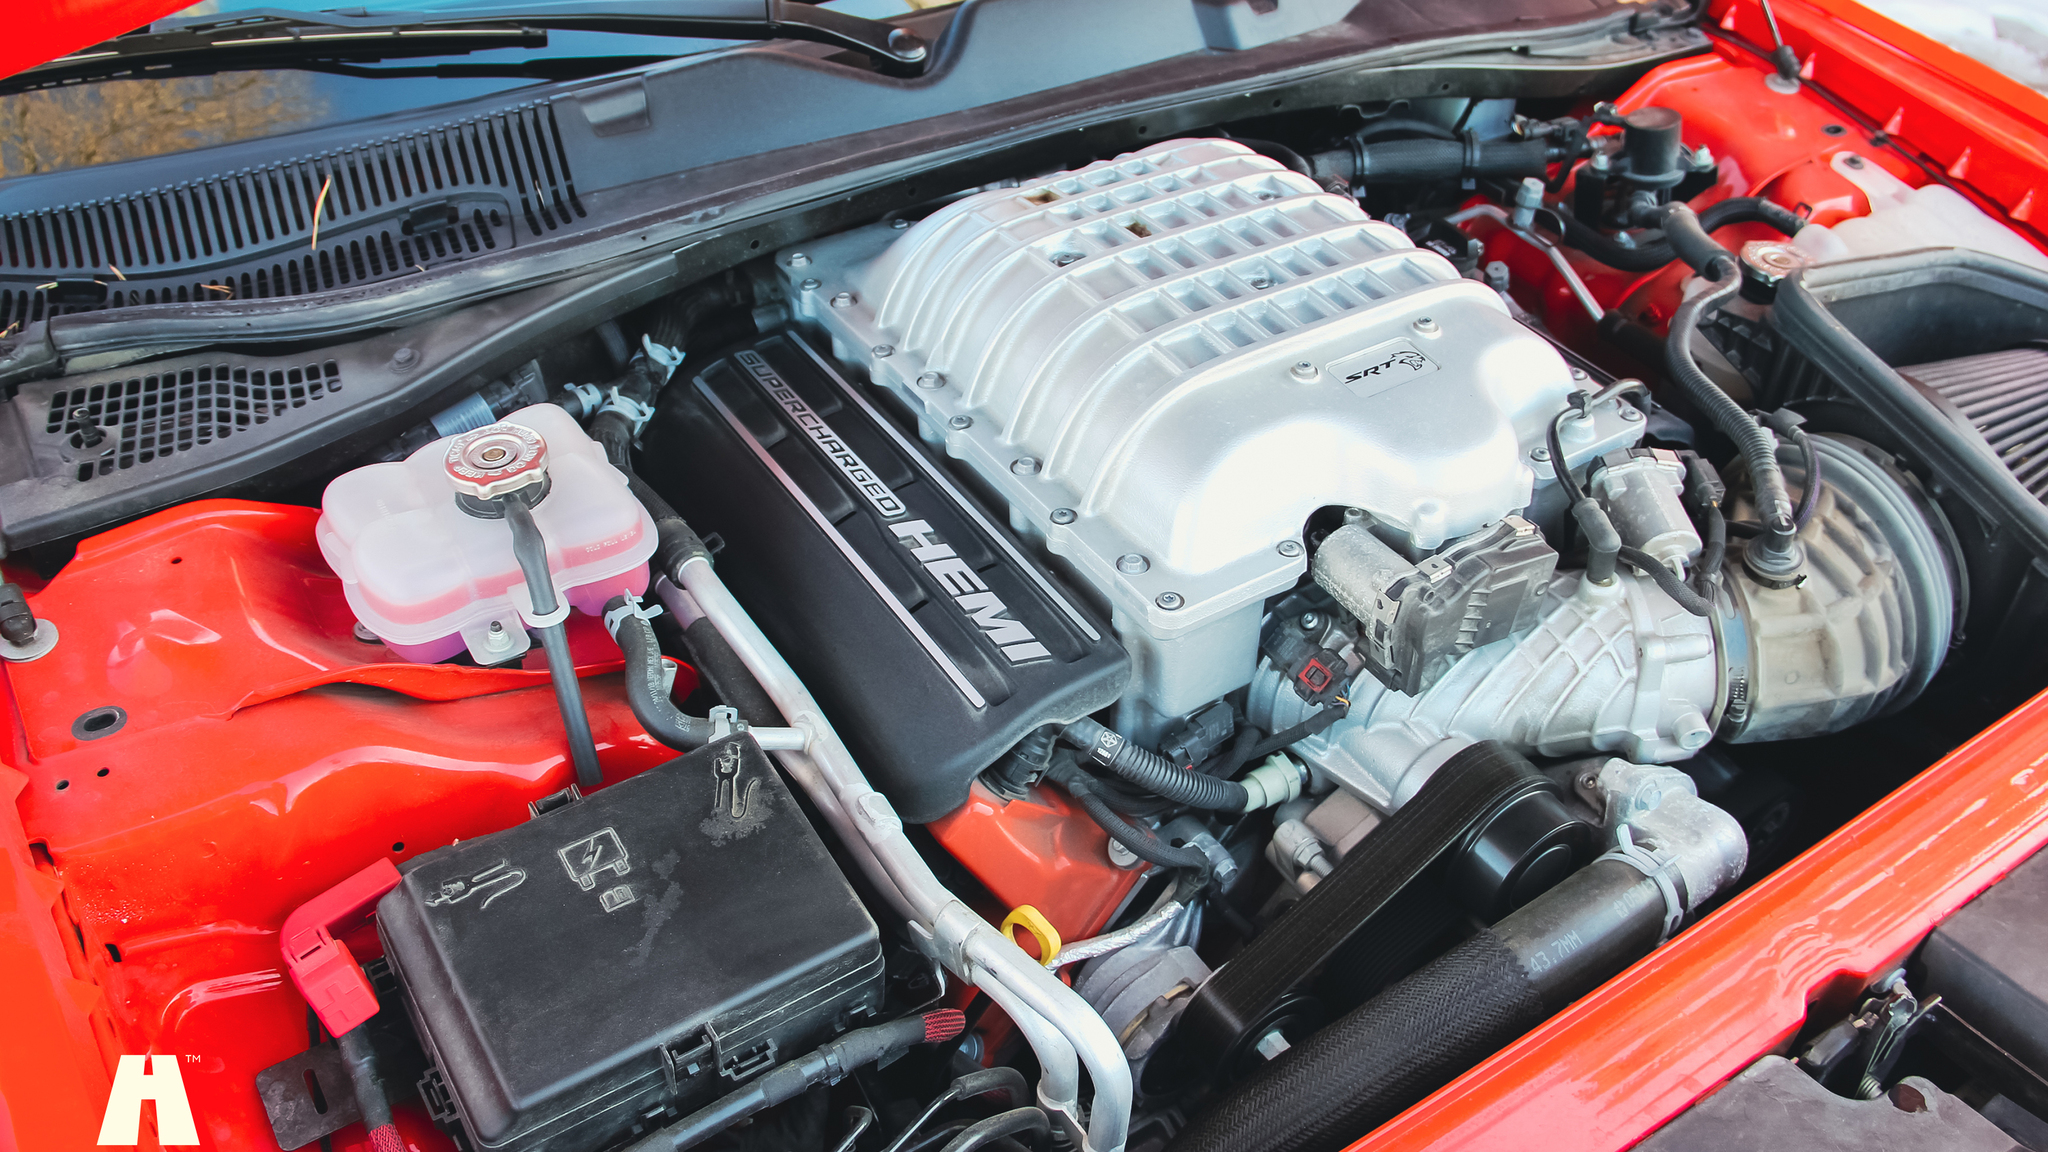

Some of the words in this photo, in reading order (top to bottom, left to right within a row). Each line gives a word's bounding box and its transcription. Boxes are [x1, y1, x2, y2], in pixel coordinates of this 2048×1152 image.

[1345, 359, 1396, 384] SRT
[738, 351, 903, 515] SUPERCHARGED
[888, 519, 1052, 665] HEMI
[1529, 930, 1583, 972] 43.7MM
